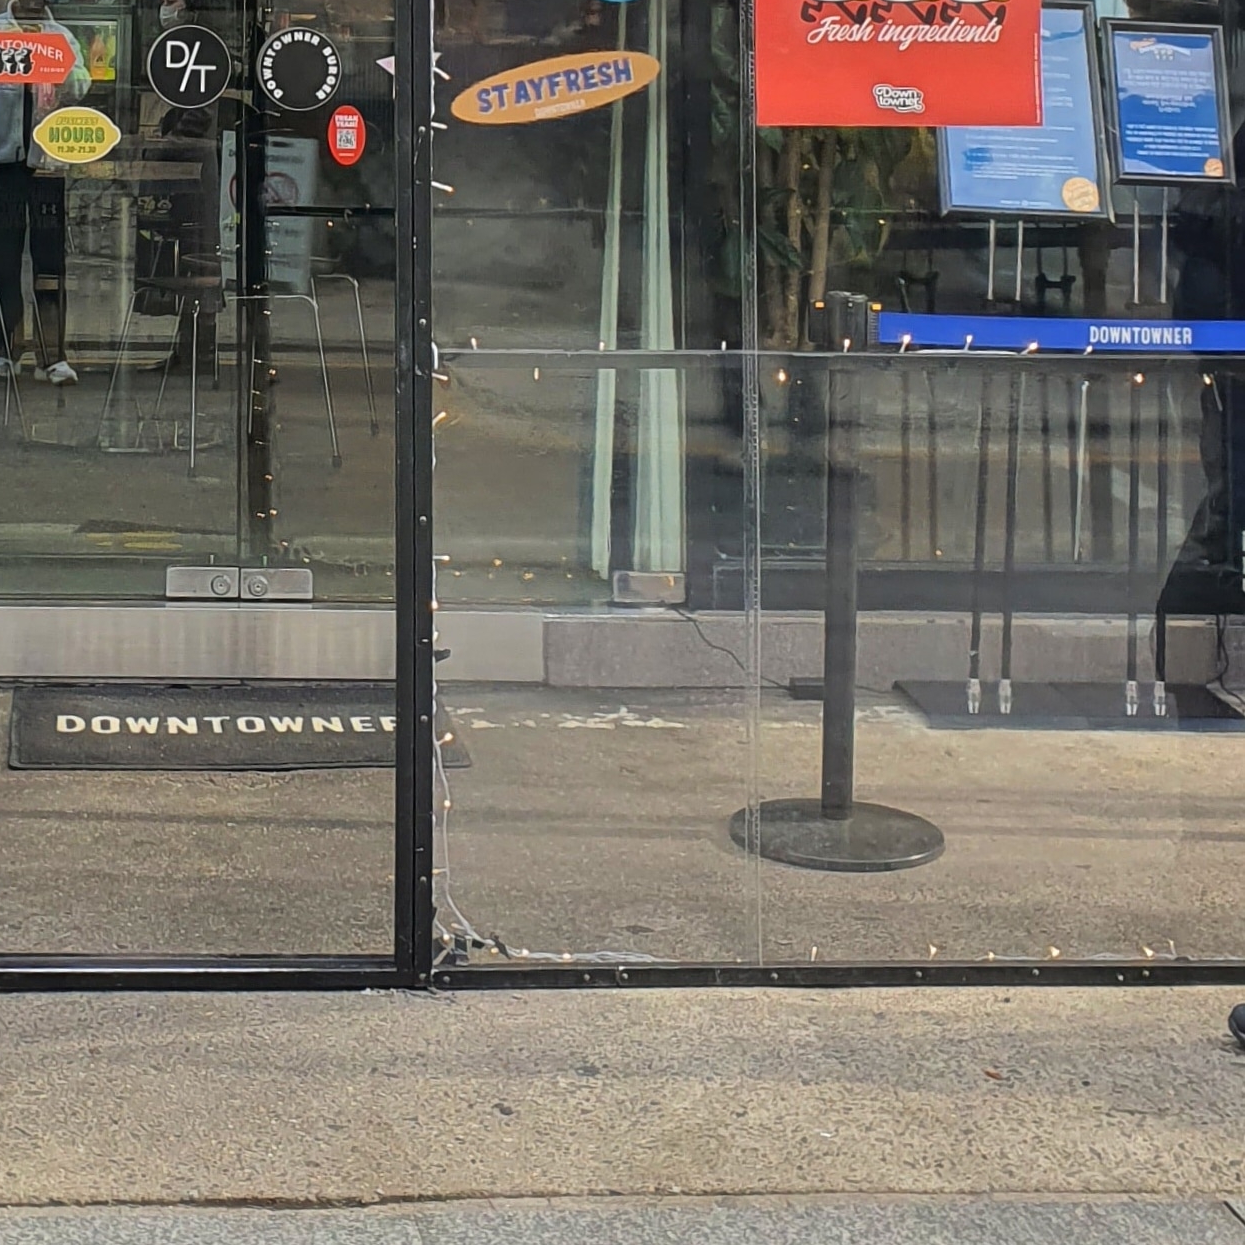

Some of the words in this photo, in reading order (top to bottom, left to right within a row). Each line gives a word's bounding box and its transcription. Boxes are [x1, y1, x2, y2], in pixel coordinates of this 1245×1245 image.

[807, 16, 874, 44] Fresh
[877, 16, 1003, 51] ingredients
[166, 40, 217, 93] D/T
[262, 31, 321, 99] DOWNTOWNER
[315, 46, 338, 100] BURGER
[48, 126, 105, 144] HOURS
[1089, 325, 1193, 345] DOWNTOWNER
